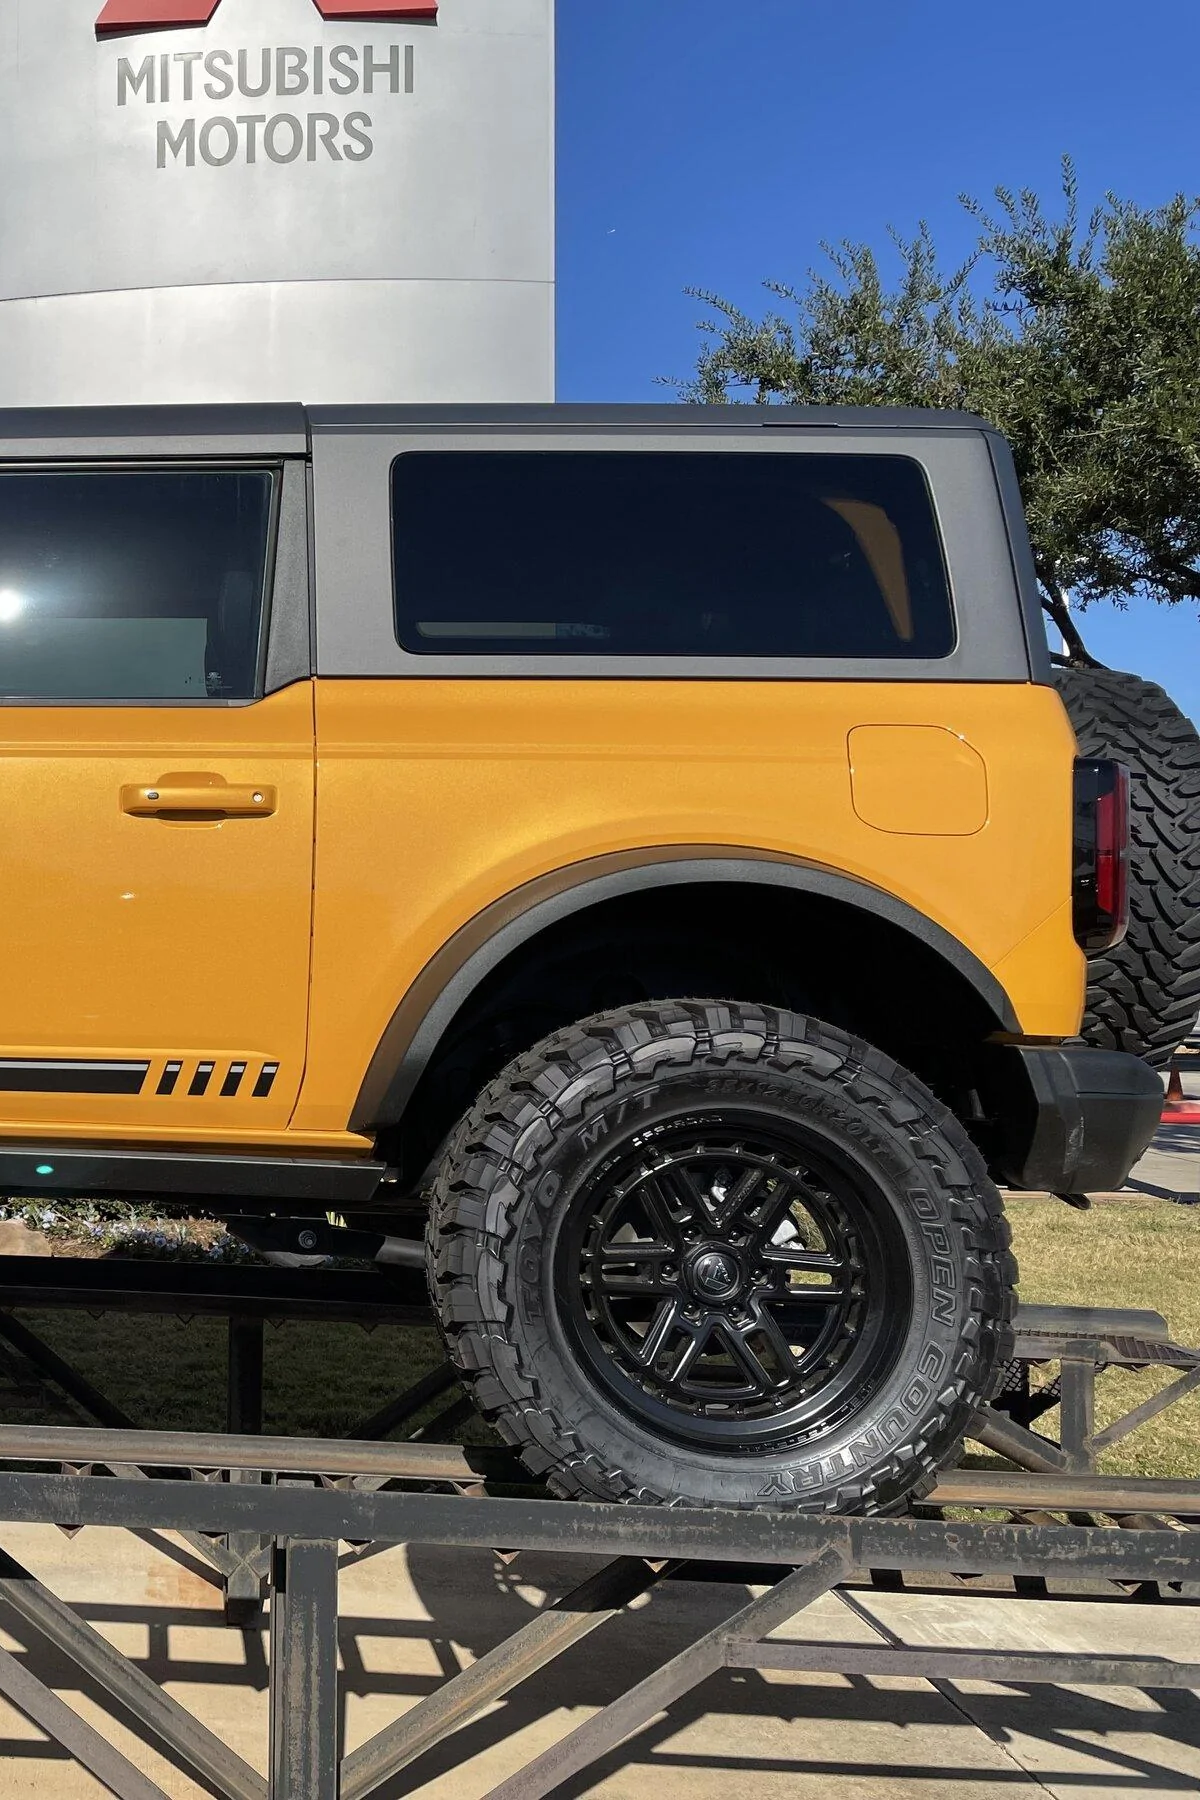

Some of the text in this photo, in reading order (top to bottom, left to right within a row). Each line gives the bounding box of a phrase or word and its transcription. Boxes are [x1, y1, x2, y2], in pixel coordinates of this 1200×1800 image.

[116, 44, 414, 106] MITSUBISHI
[156, 111, 373, 169] MOTORS
[518, 1085, 661, 1326] TOYO M/T
[906, 1188, 956, 1327] OPEN
[756, 1340, 947, 1498] COUNTRY
